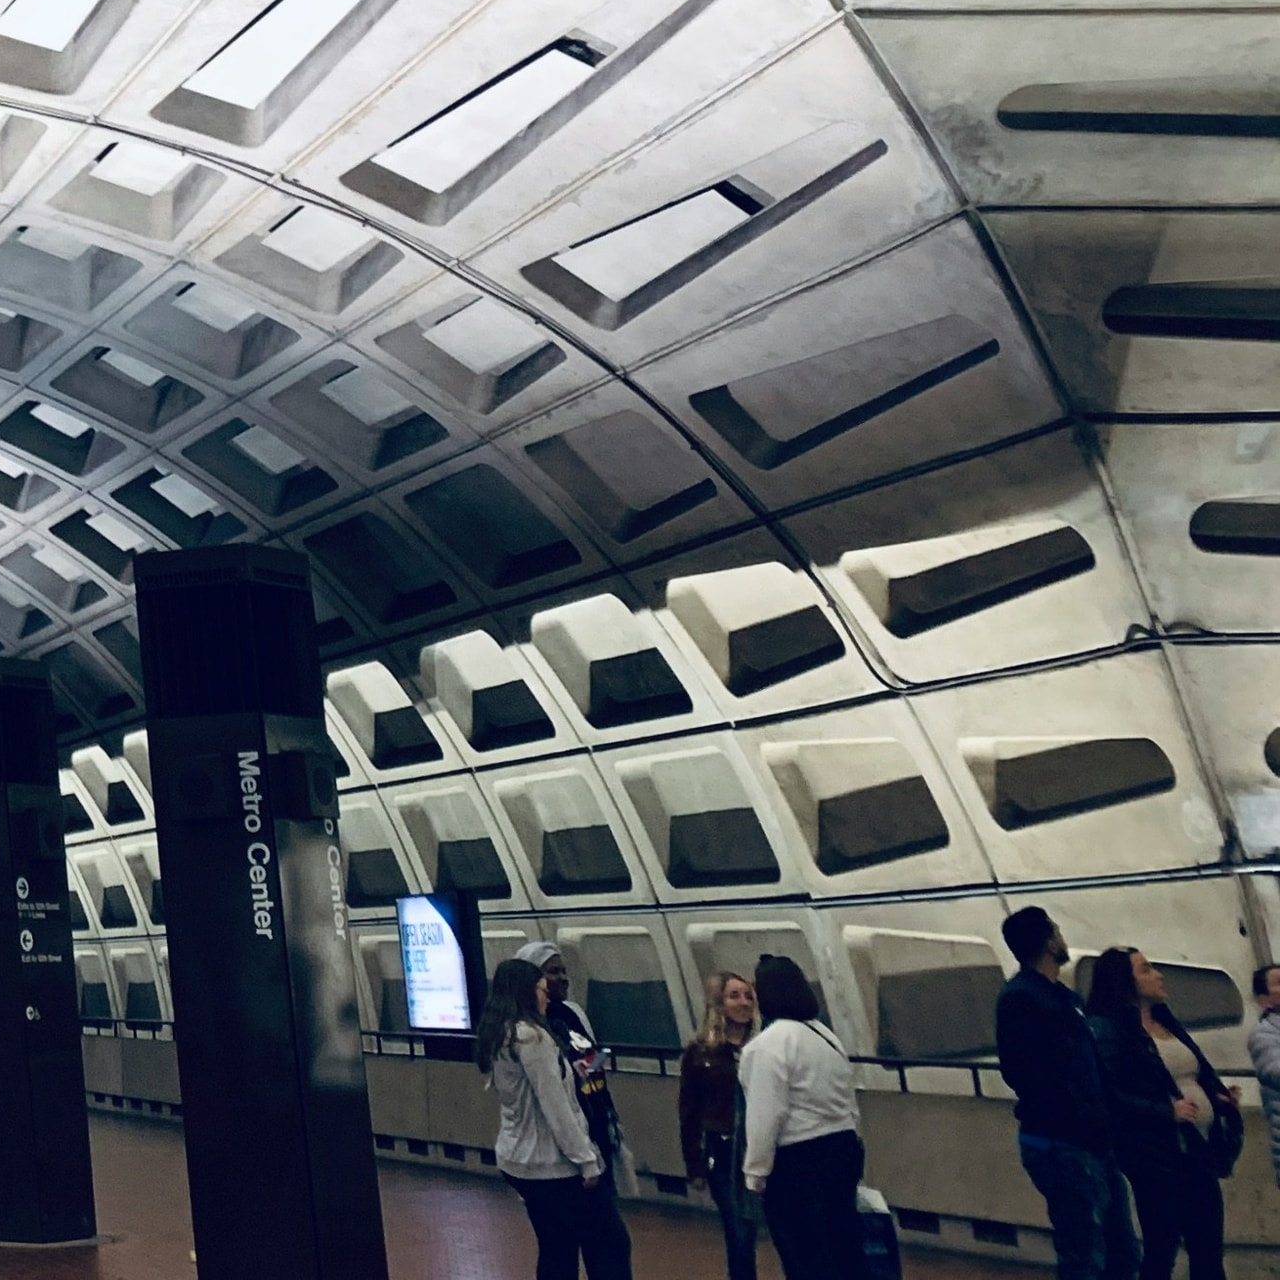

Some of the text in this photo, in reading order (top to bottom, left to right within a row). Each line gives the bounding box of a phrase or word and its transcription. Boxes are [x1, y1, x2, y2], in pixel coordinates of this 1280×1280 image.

[237, 750, 275, 941] Metro Center
[327, 845, 346, 941] Center
